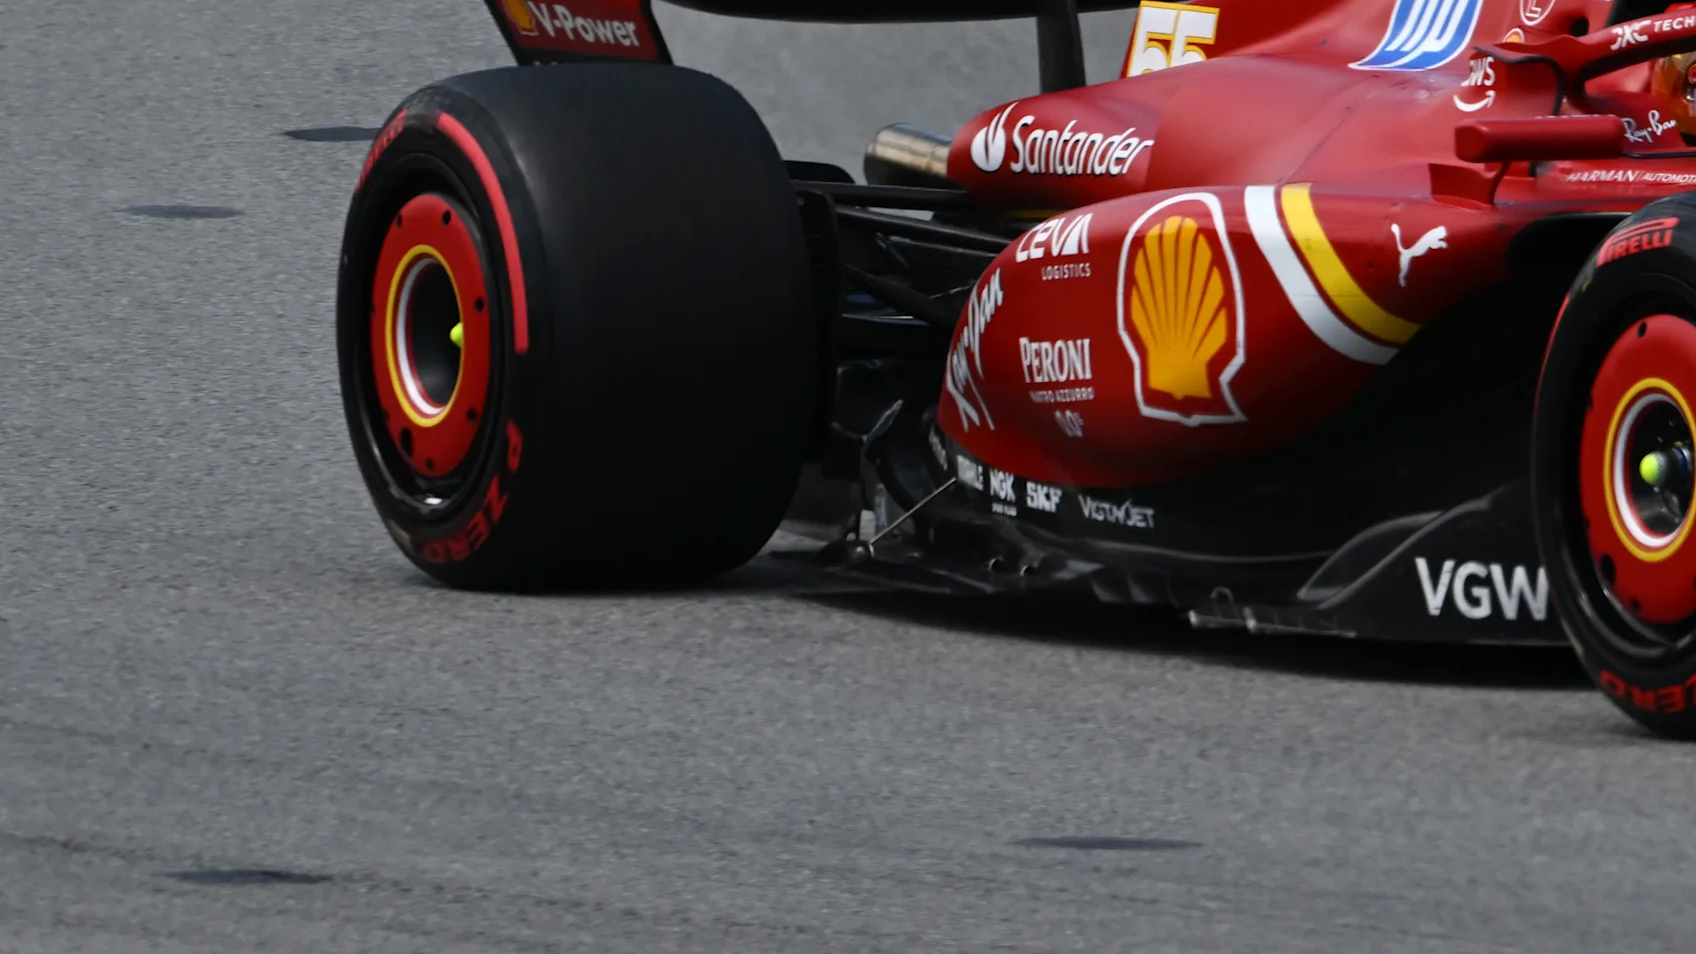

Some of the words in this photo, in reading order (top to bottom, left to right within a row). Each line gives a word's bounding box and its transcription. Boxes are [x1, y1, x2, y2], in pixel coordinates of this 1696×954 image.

[528, 0, 640, 47] V-Power
[1127, 0, 1220, 77] 55
[1010, 114, 1154, 176] Santander
[1621, 110, 1678, 142] Ray-Ban
[1566, 170, 1639, 183] HARMAN
[1597, 217, 1680, 267] PIRELLI
[1042, 263, 1092, 280] LOGISTICS
[1019, 337, 1093, 383] PERONI
[989, 468, 1016, 502] NGK
[1026, 481, 1062, 514] SKF
[1415, 557, 1550, 620] VGW
